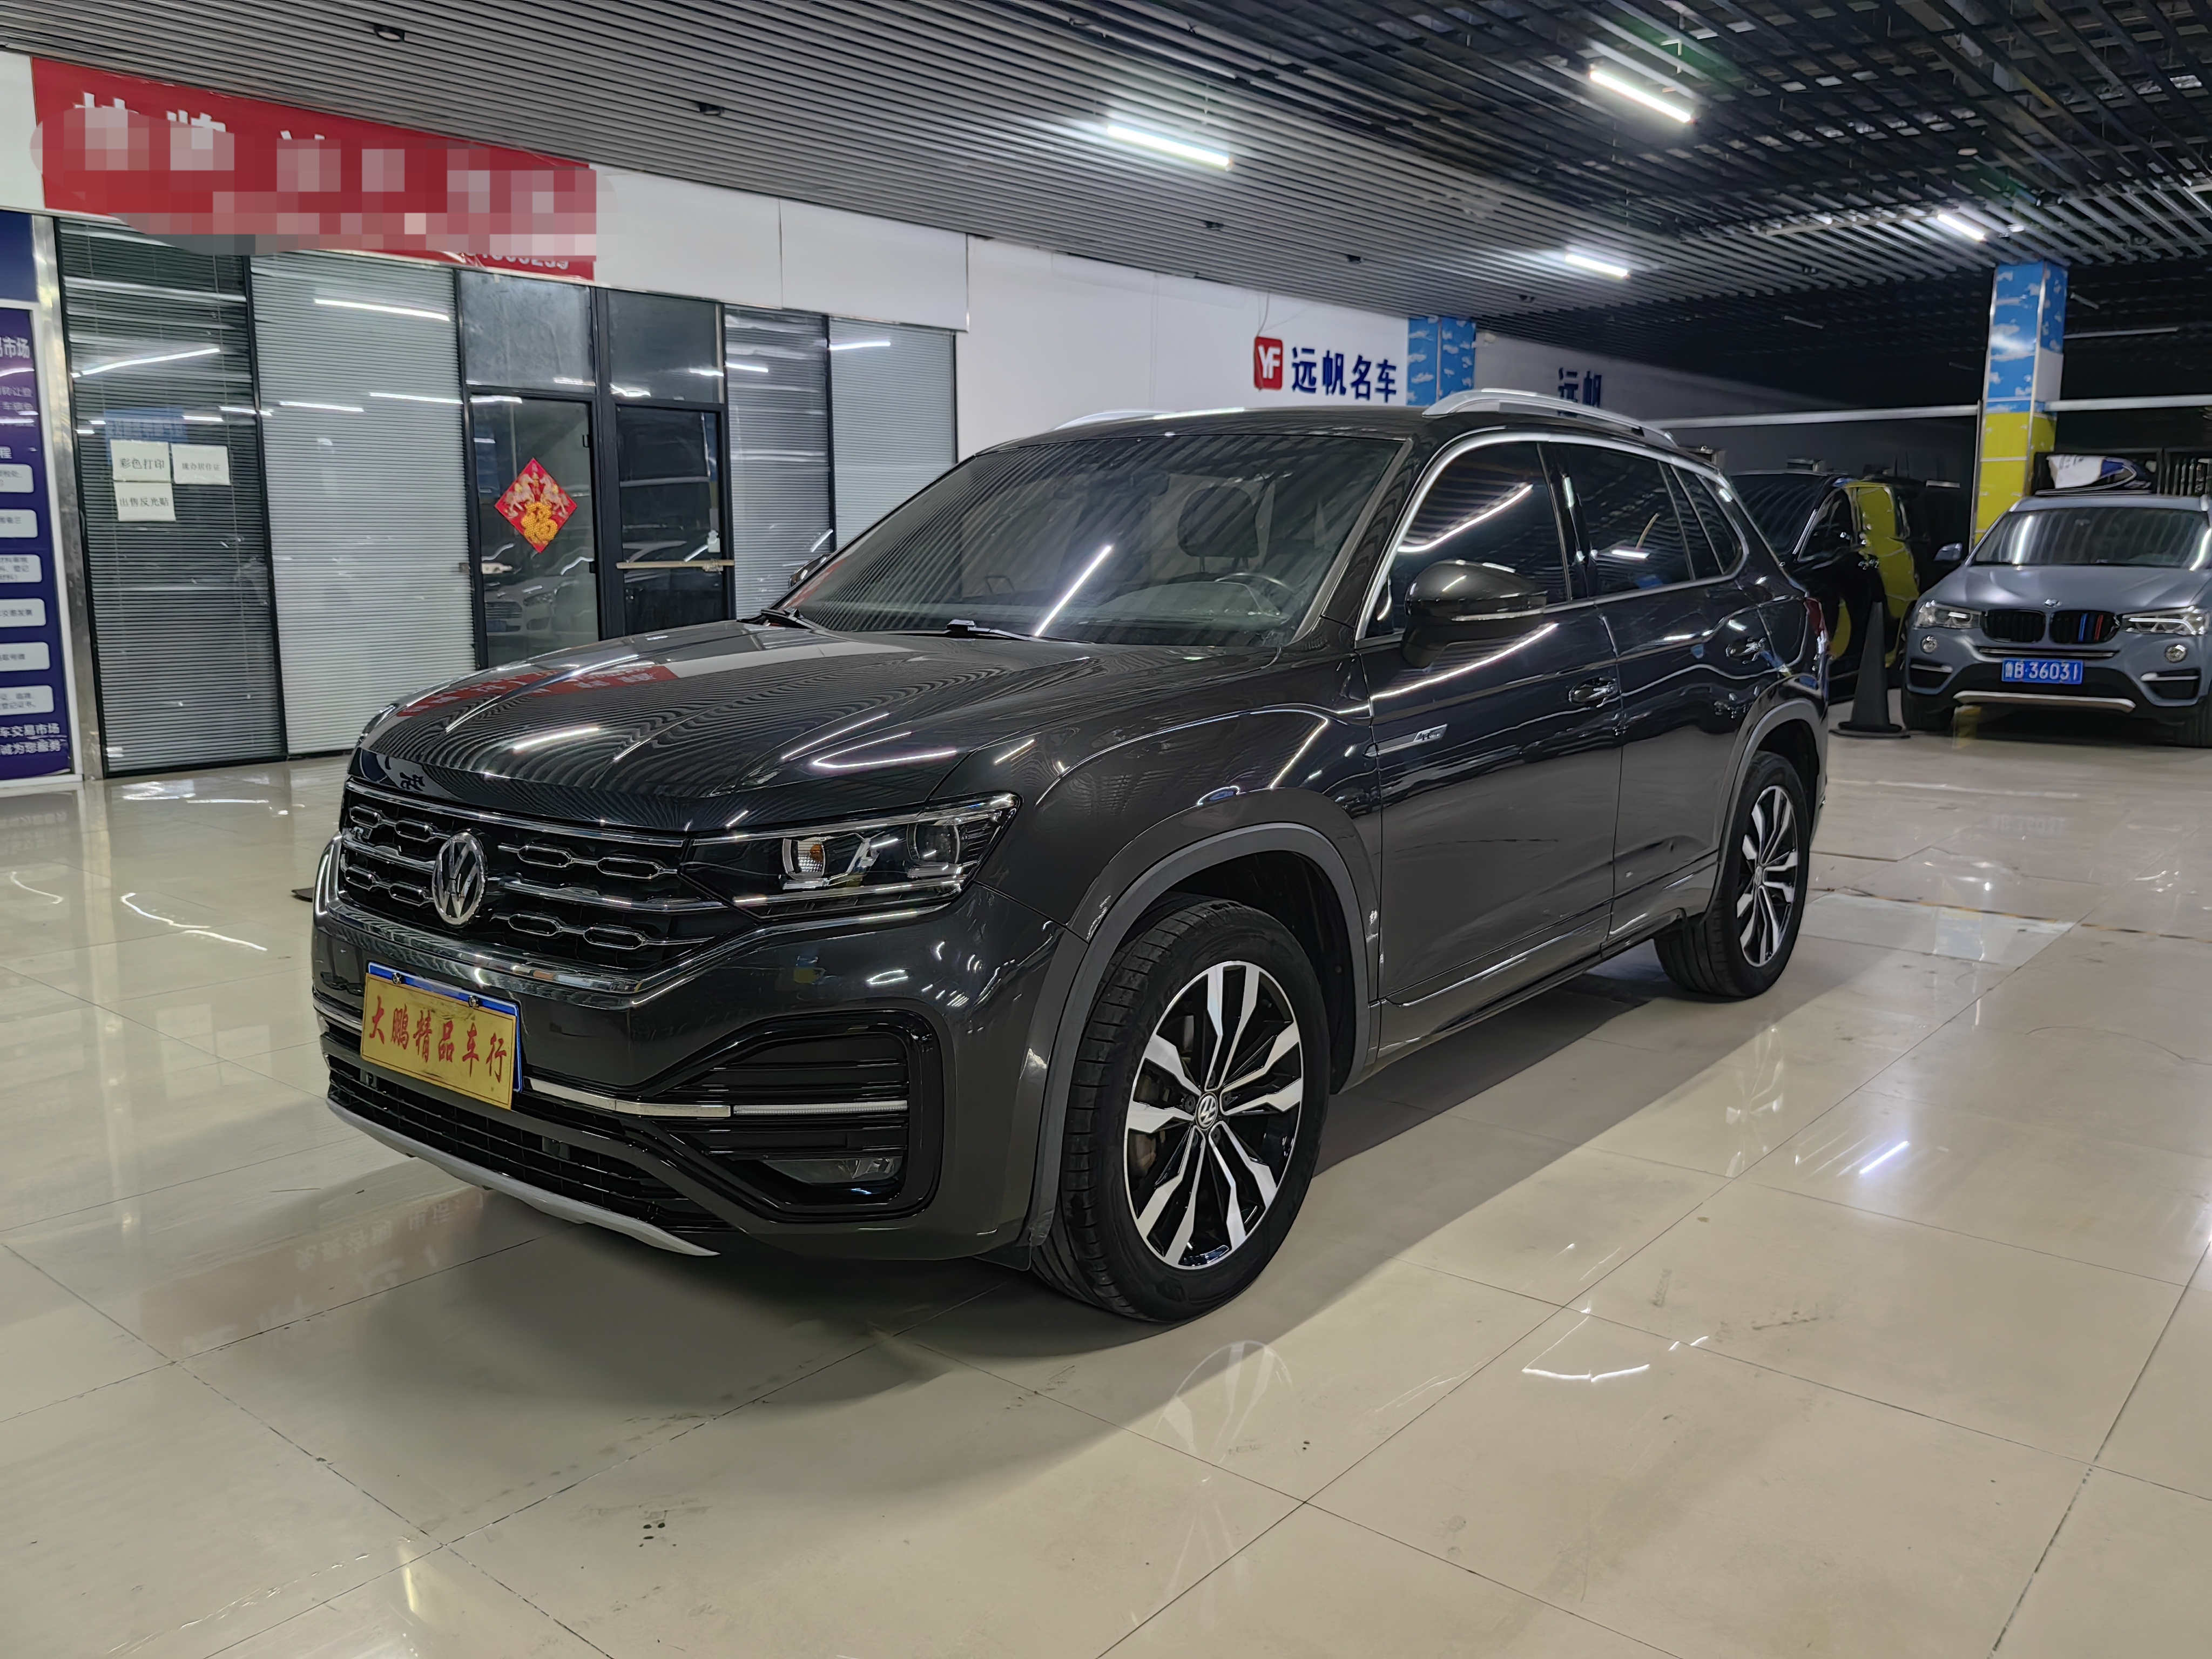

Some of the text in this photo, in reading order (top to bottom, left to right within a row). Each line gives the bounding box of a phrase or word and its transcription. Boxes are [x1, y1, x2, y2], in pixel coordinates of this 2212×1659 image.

[1258, 345, 1397, 403] YF 远帆名车
[120, 457, 165, 470] 彩色打印
[369, 995, 507, 1083] 大鹏精品车行
